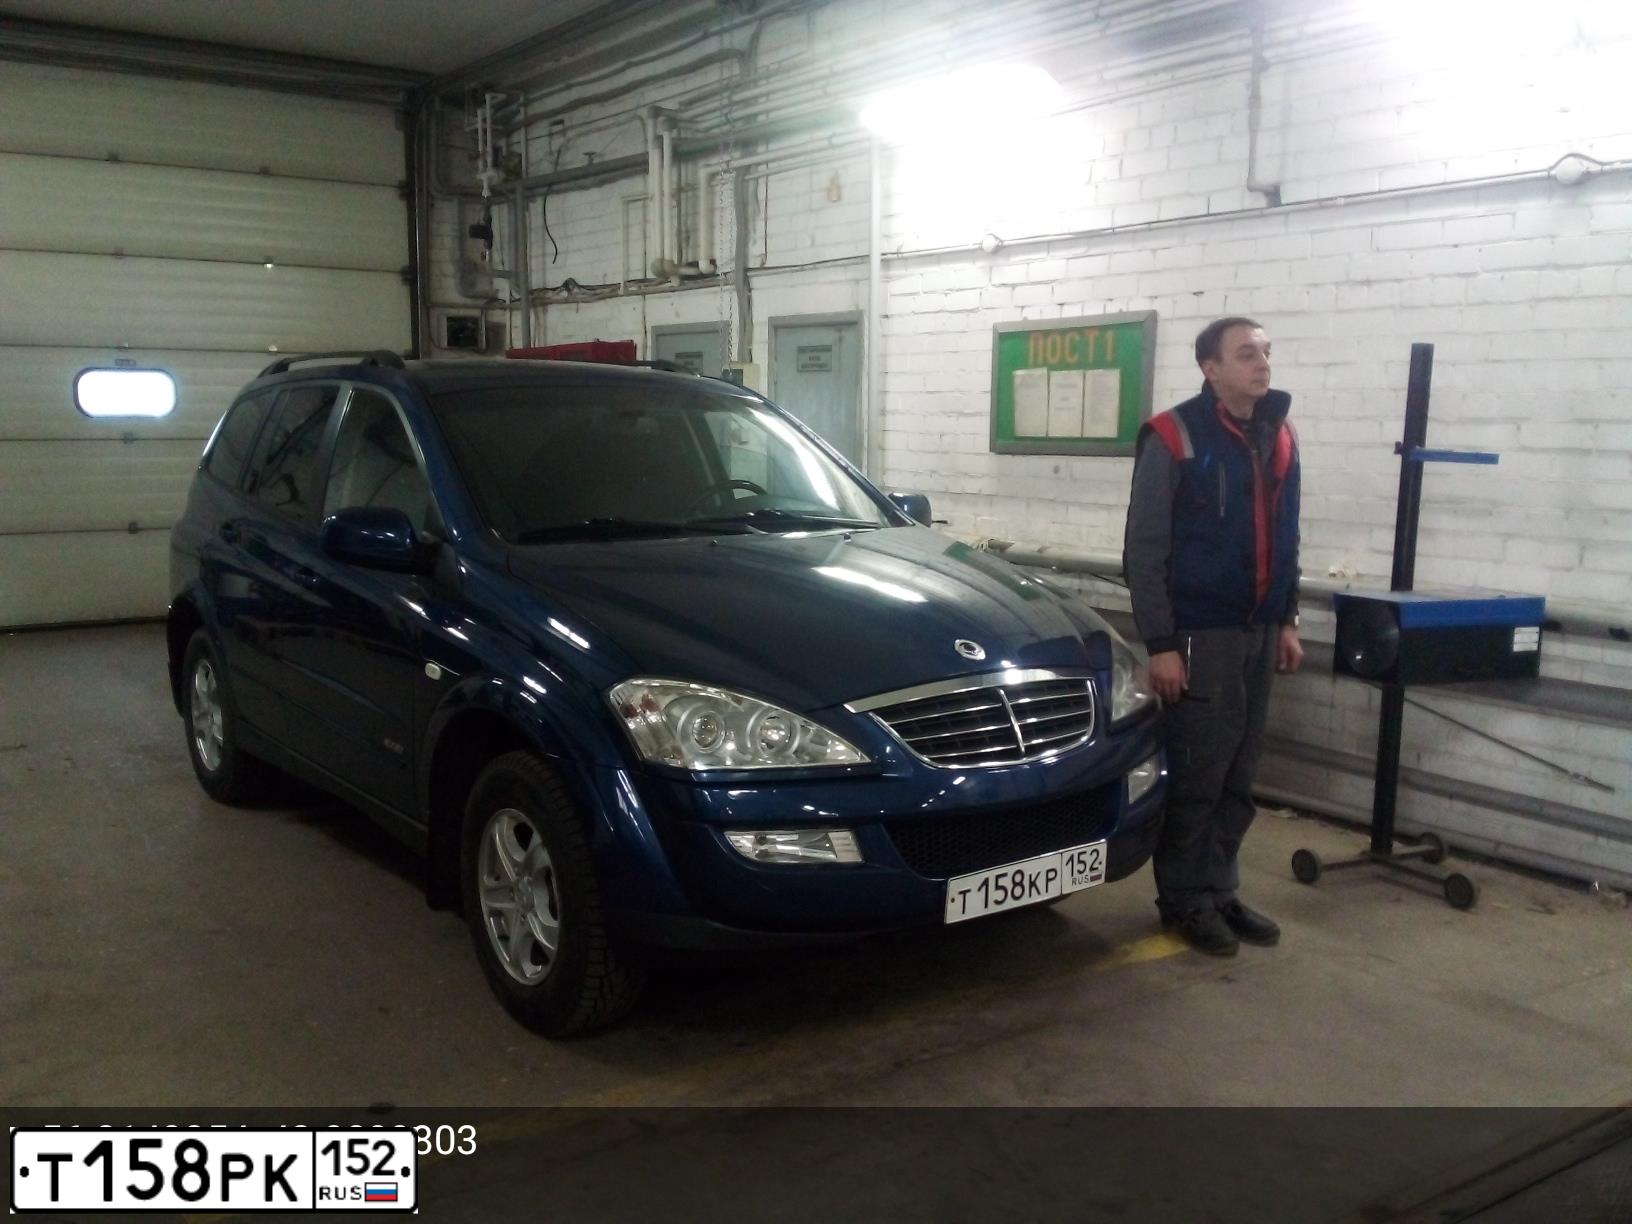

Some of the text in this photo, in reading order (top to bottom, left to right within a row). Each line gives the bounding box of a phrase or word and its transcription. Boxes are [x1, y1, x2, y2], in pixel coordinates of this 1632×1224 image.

[1065, 849, 1100, 877] 152
[958, 868, 1058, 914] Т158КР
[1071, 876, 1089, 886] RUS
